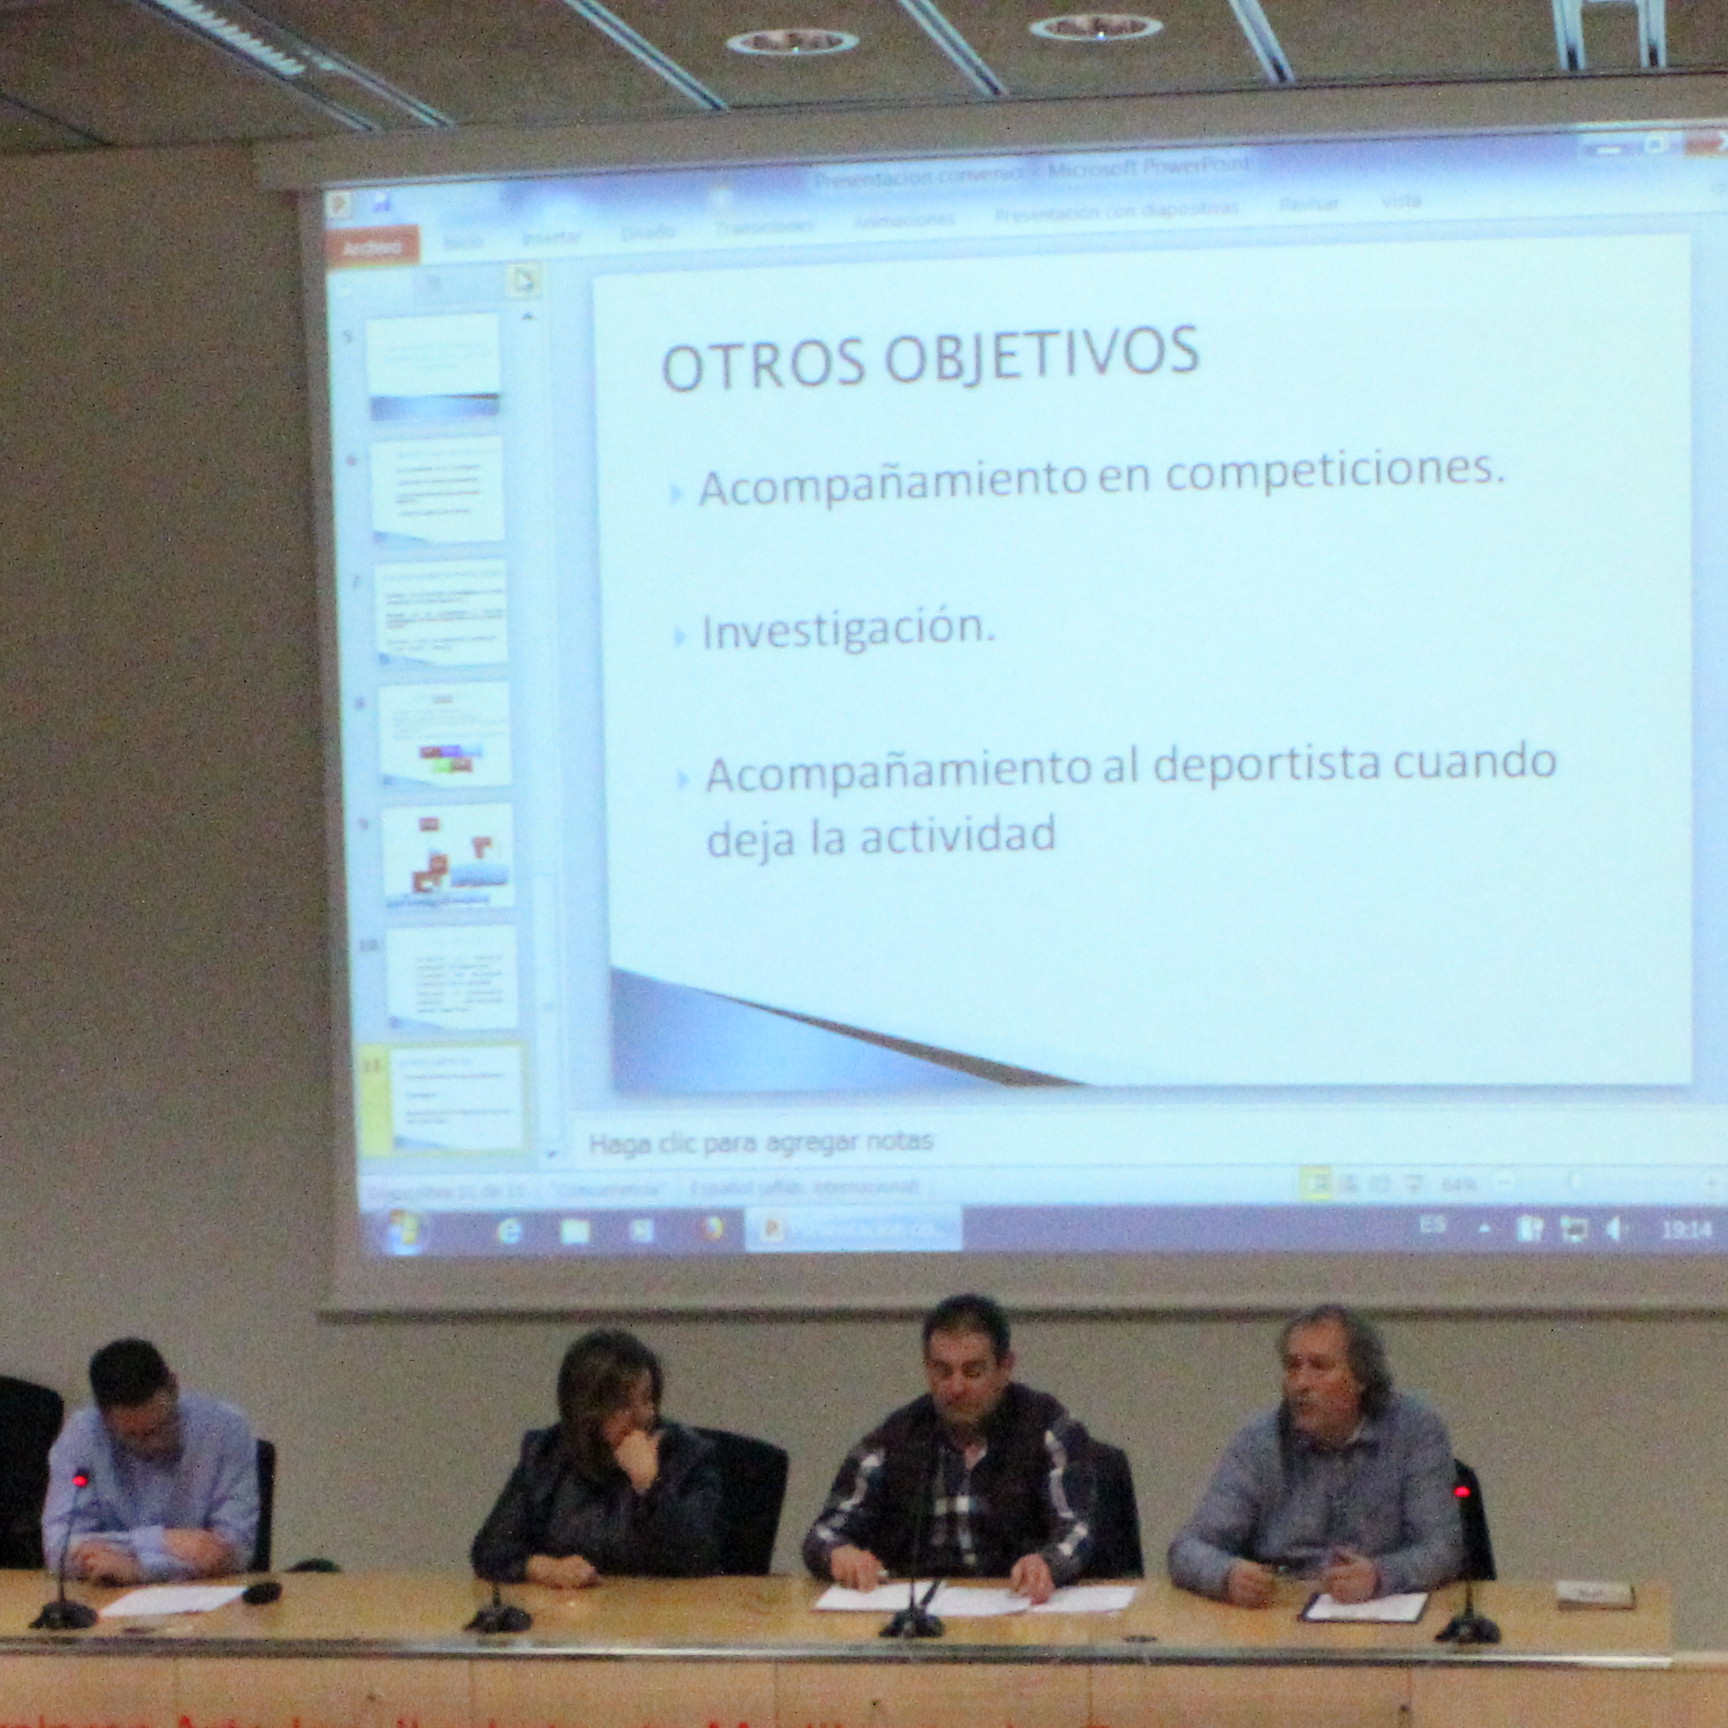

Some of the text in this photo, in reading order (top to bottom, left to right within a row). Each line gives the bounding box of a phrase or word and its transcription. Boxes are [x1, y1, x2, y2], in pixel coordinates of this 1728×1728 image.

[662, 323, 1201, 393] OTROS OBJETIVOS
[699, 448, 1508, 511] Acompañamiento en competiciones.
[703, 603, 998, 656] Investigación.
[706, 737, 1559, 801] Acompañamiento al deportista cuando
[707, 813, 1058, 868] deja la actividad
[588, 1129, 935, 1161] Haga clic para agregar notas
